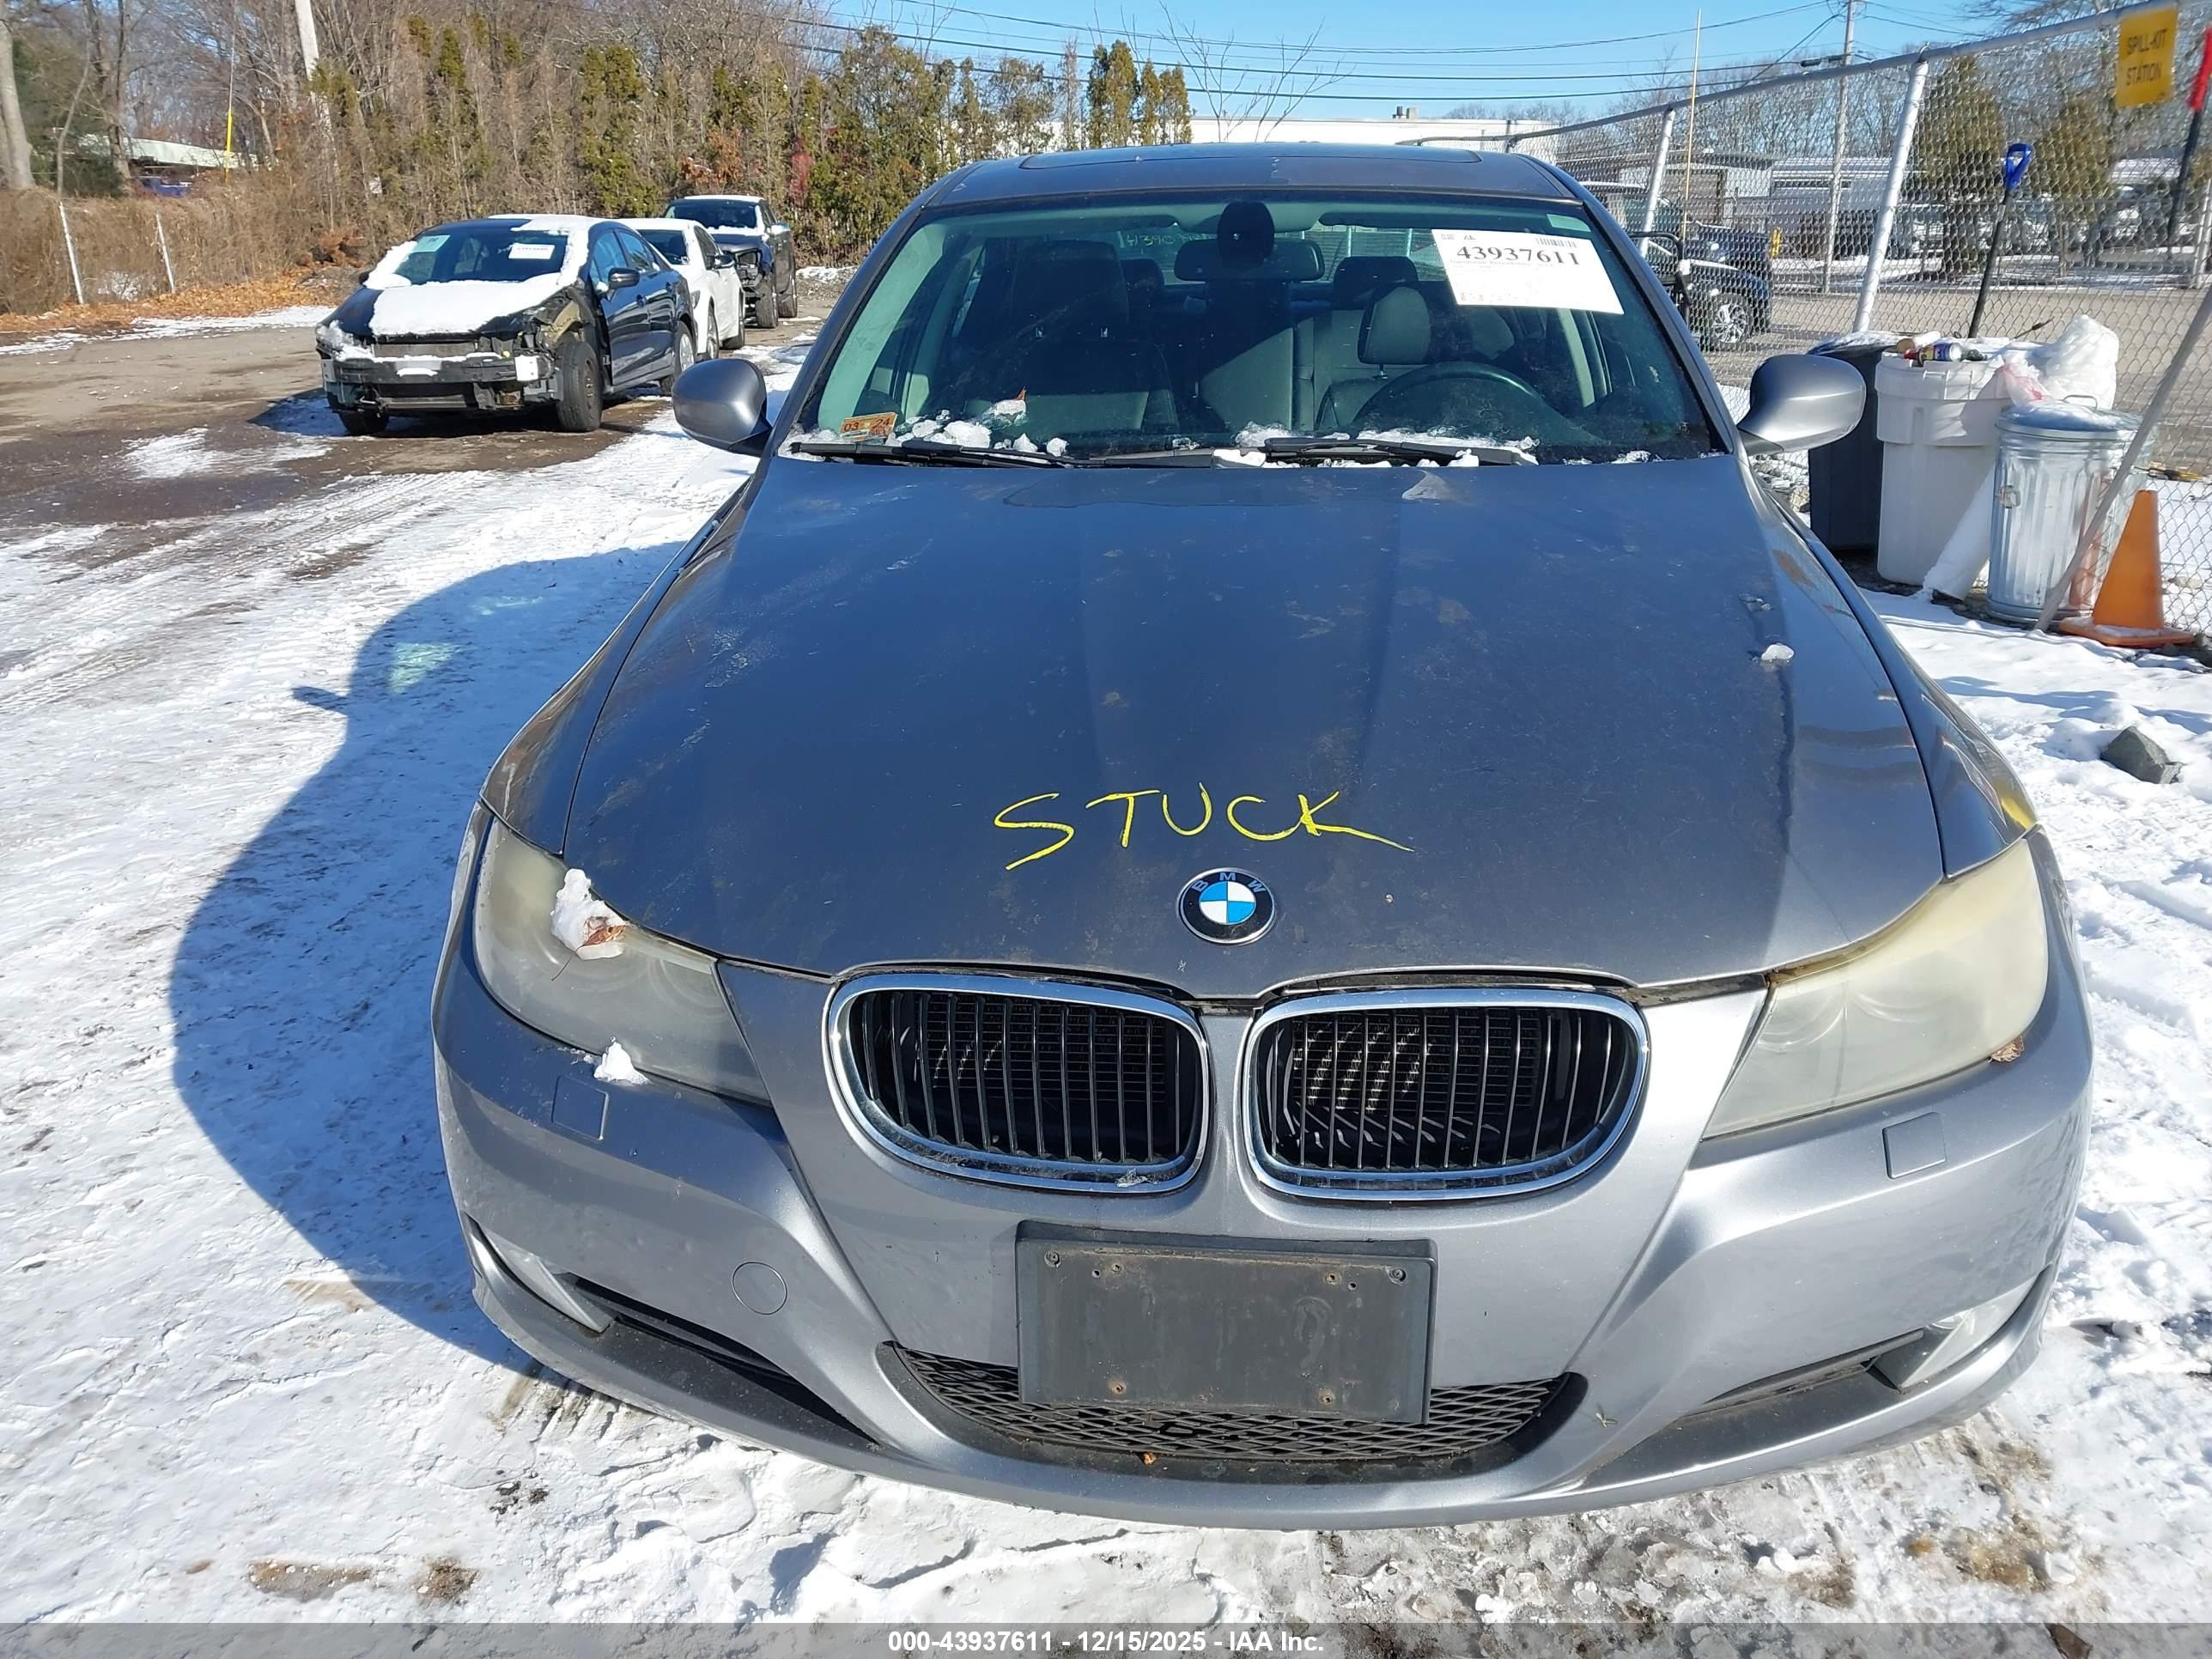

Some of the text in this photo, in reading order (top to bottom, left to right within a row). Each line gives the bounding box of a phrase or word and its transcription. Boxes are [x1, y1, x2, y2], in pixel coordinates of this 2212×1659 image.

[2125, 63, 2163, 86] STATION
[1456, 246, 1580, 265] 43937611
[843, 422, 860, 433] 03
[994, 781, 1415, 871] STUCK
[1191, 872, 1267, 893] BMW
